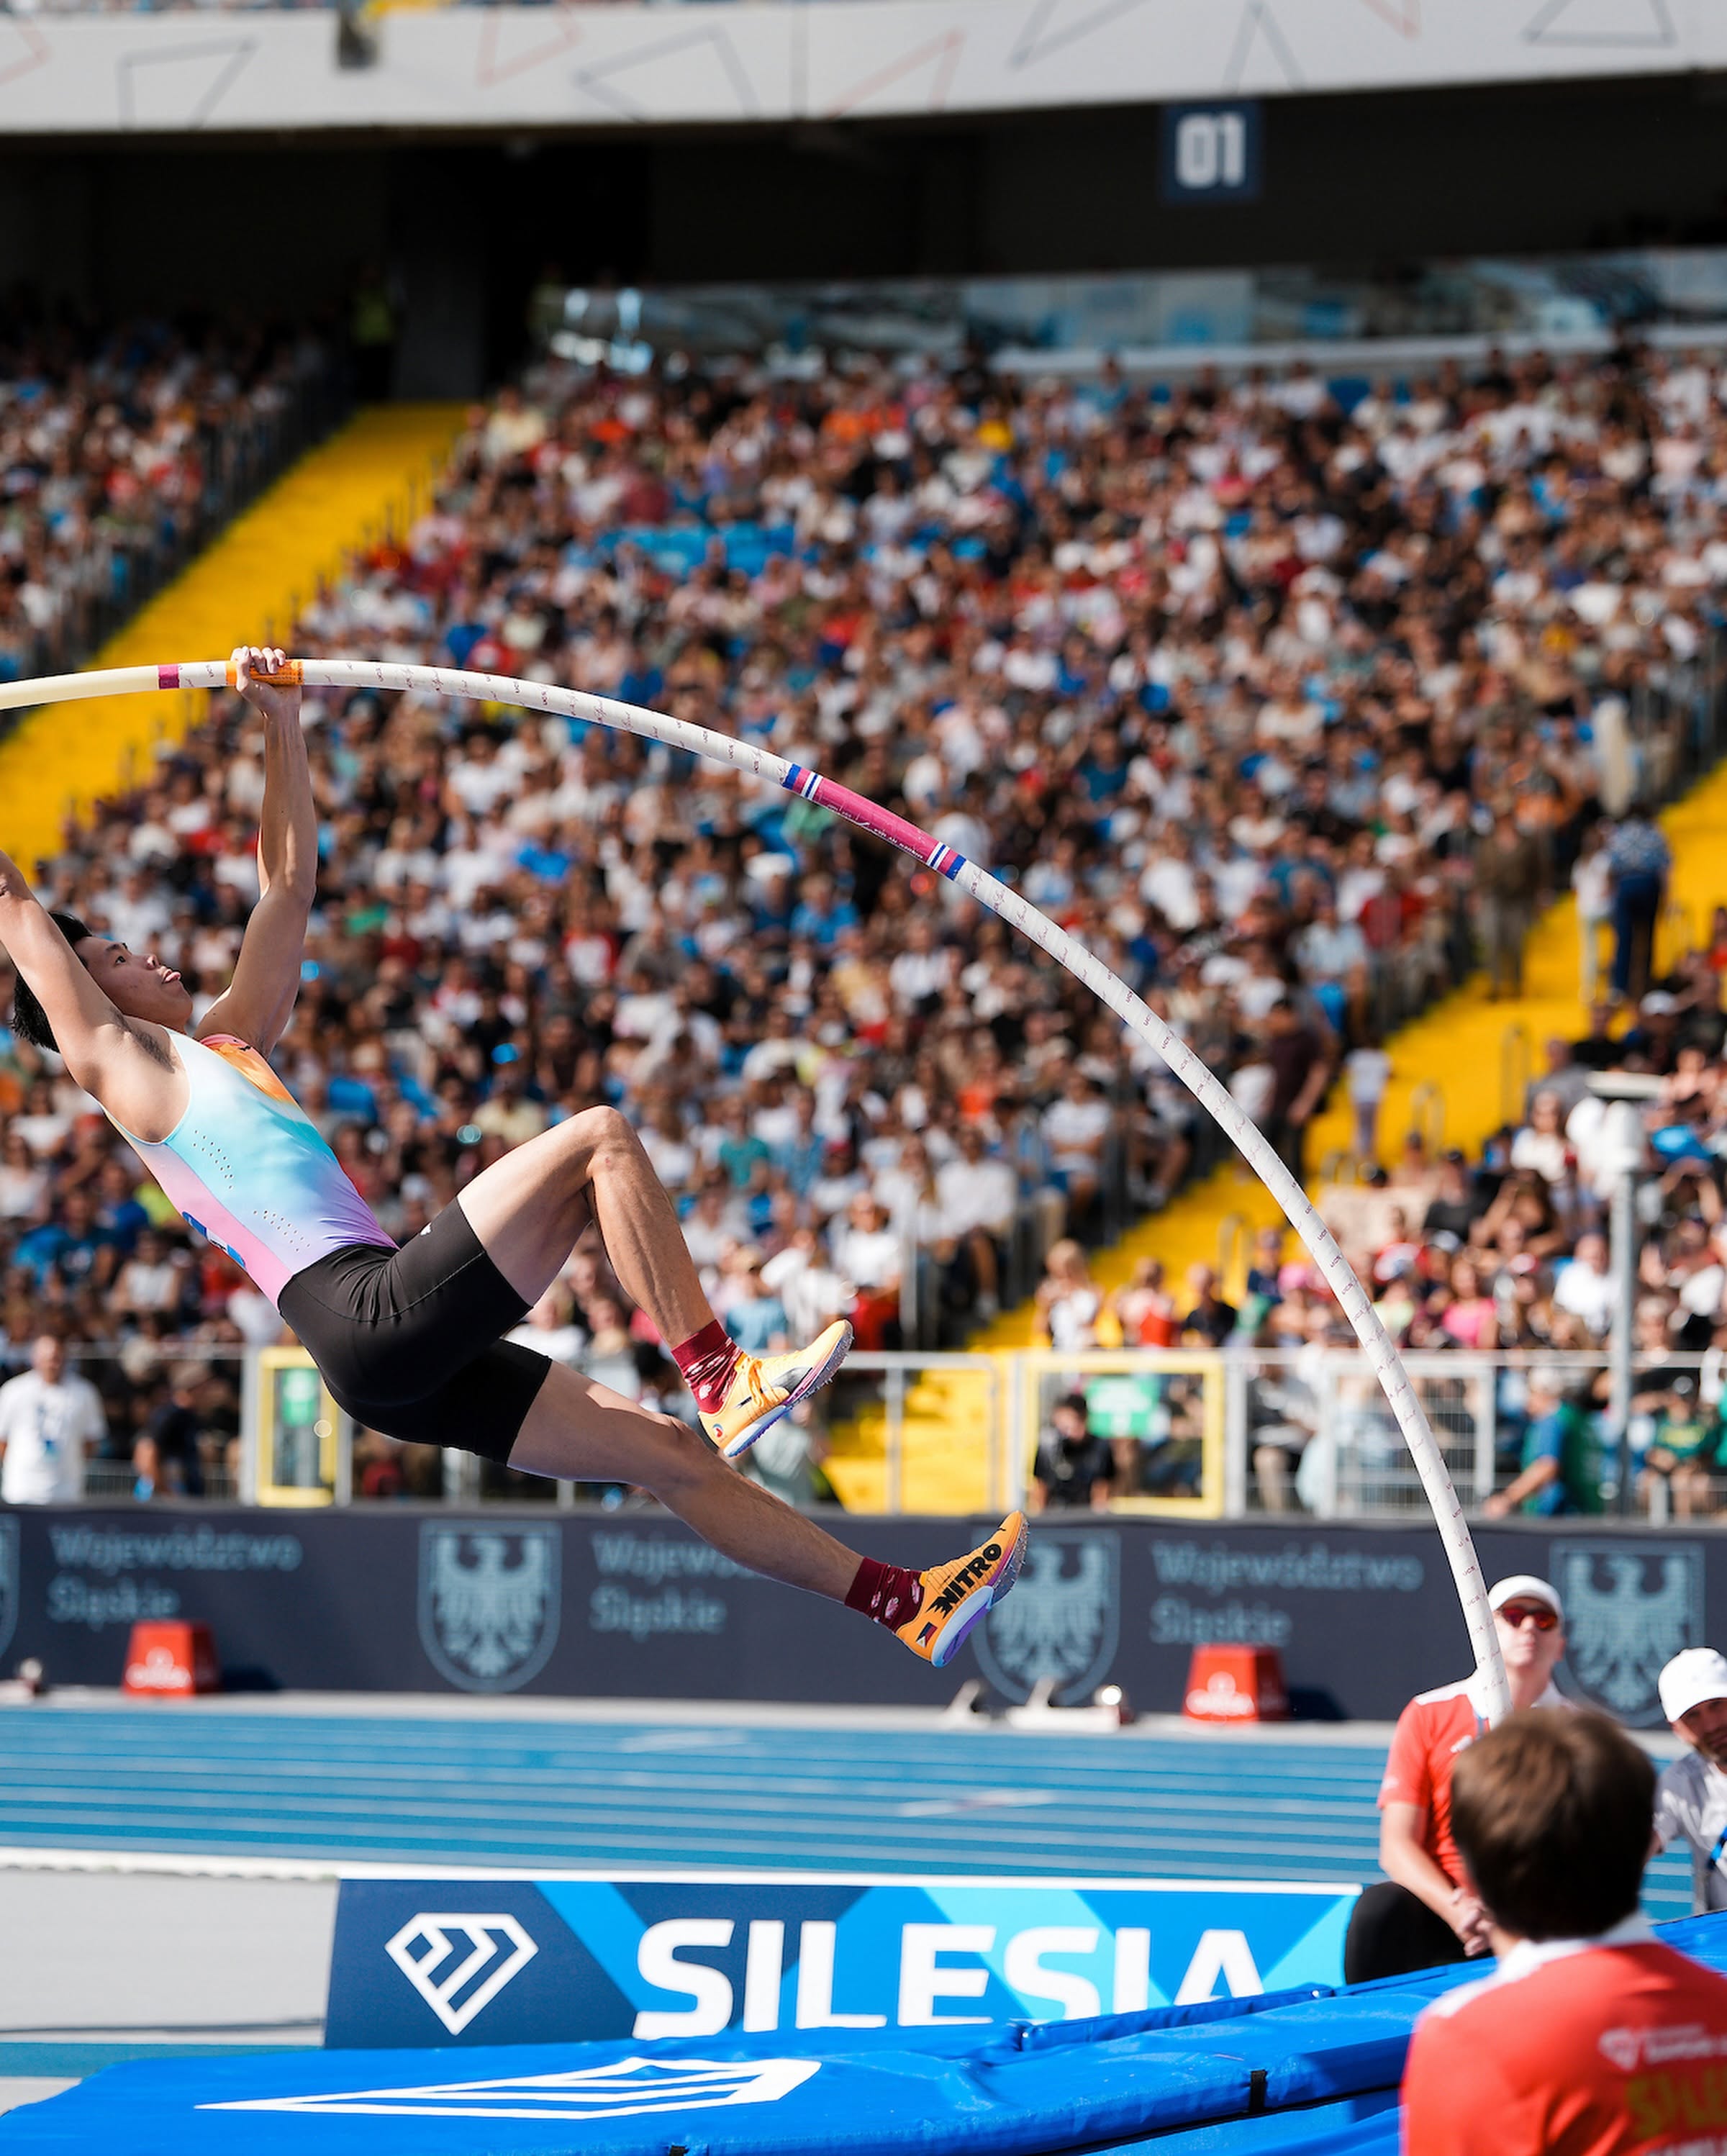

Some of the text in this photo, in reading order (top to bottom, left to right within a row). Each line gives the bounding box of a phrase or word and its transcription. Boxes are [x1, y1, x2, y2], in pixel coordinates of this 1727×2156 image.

[1177, 114, 1246, 189] 01
[926, 1543, 1002, 1619] NITRO
[633, 1918, 1264, 2041] SILESIA
